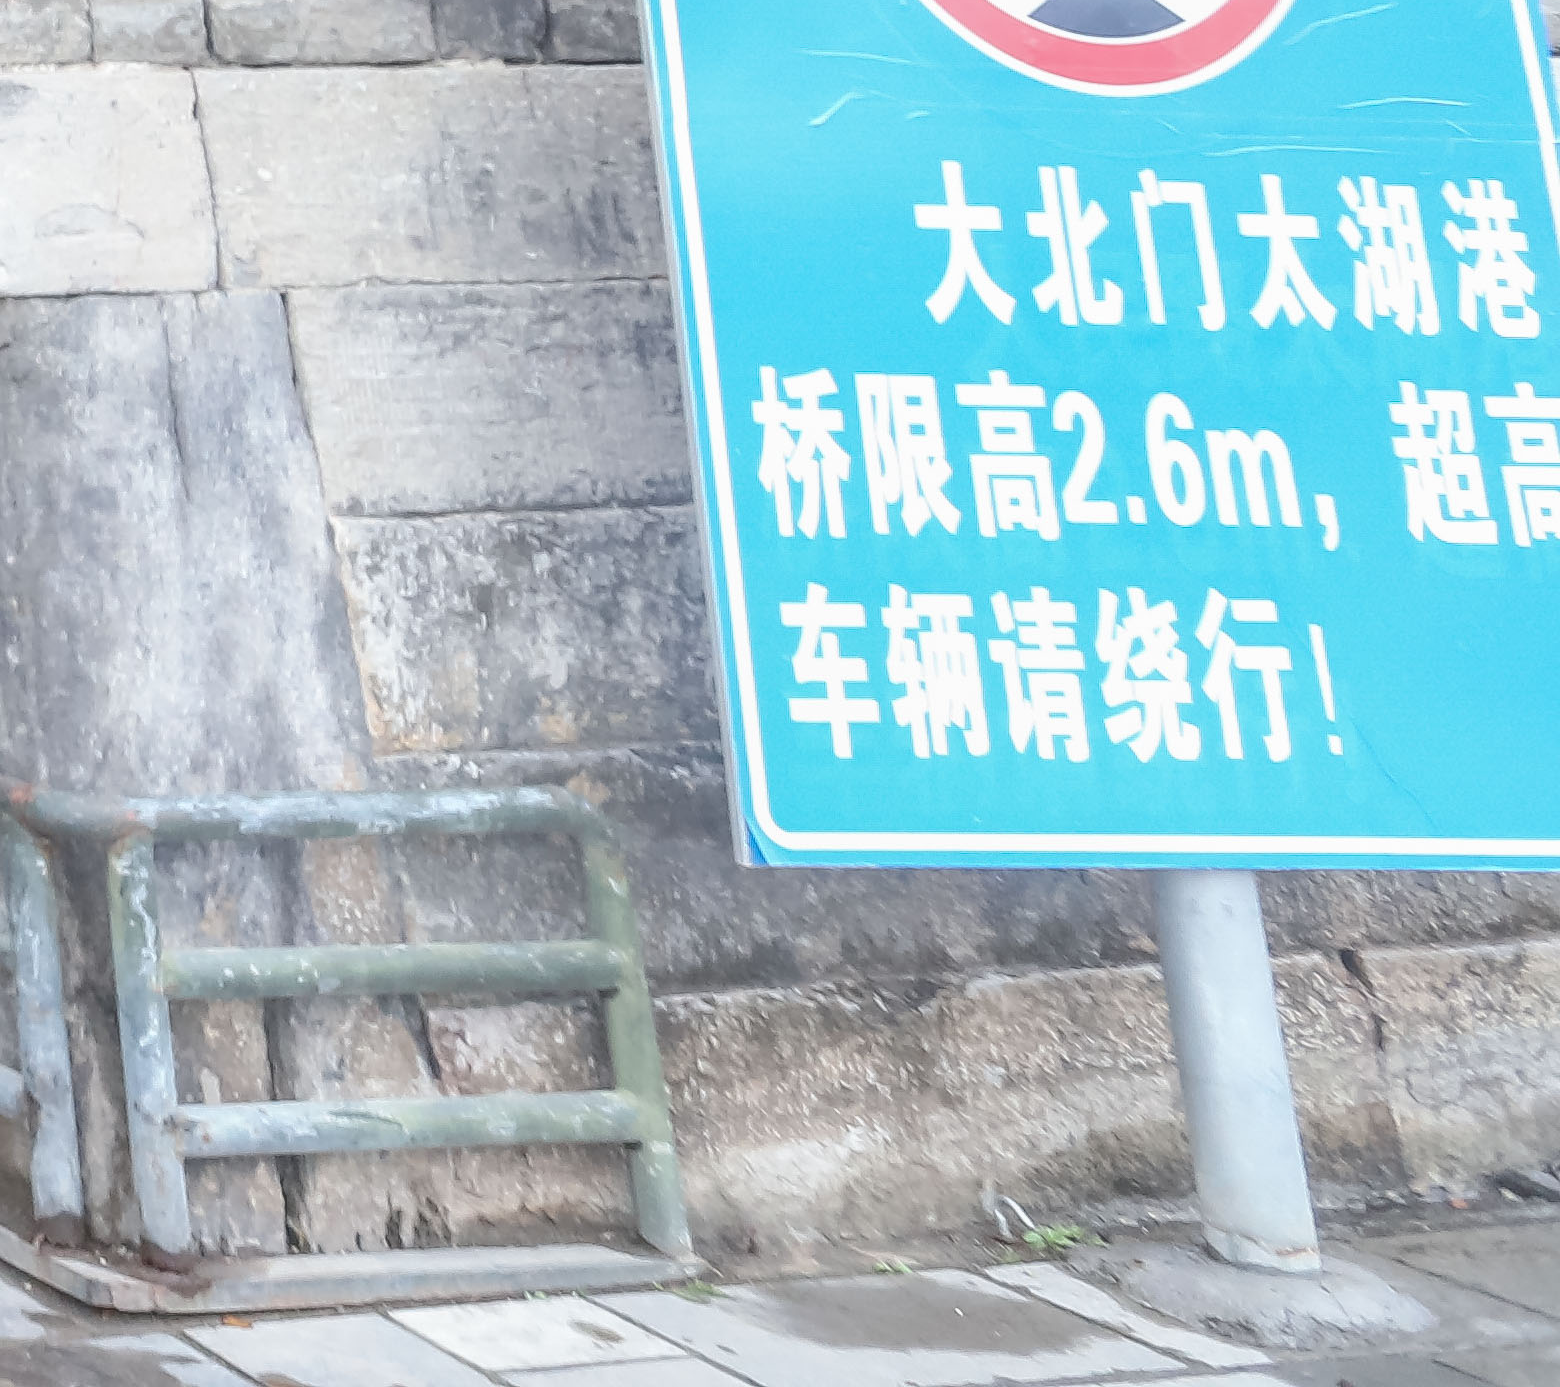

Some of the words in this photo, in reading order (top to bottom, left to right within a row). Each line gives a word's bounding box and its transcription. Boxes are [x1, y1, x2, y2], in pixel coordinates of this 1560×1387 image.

[913, 160, 1540, 339] 大北门太湖港
[779, 582, 1345, 765] 车辆请绕行！
